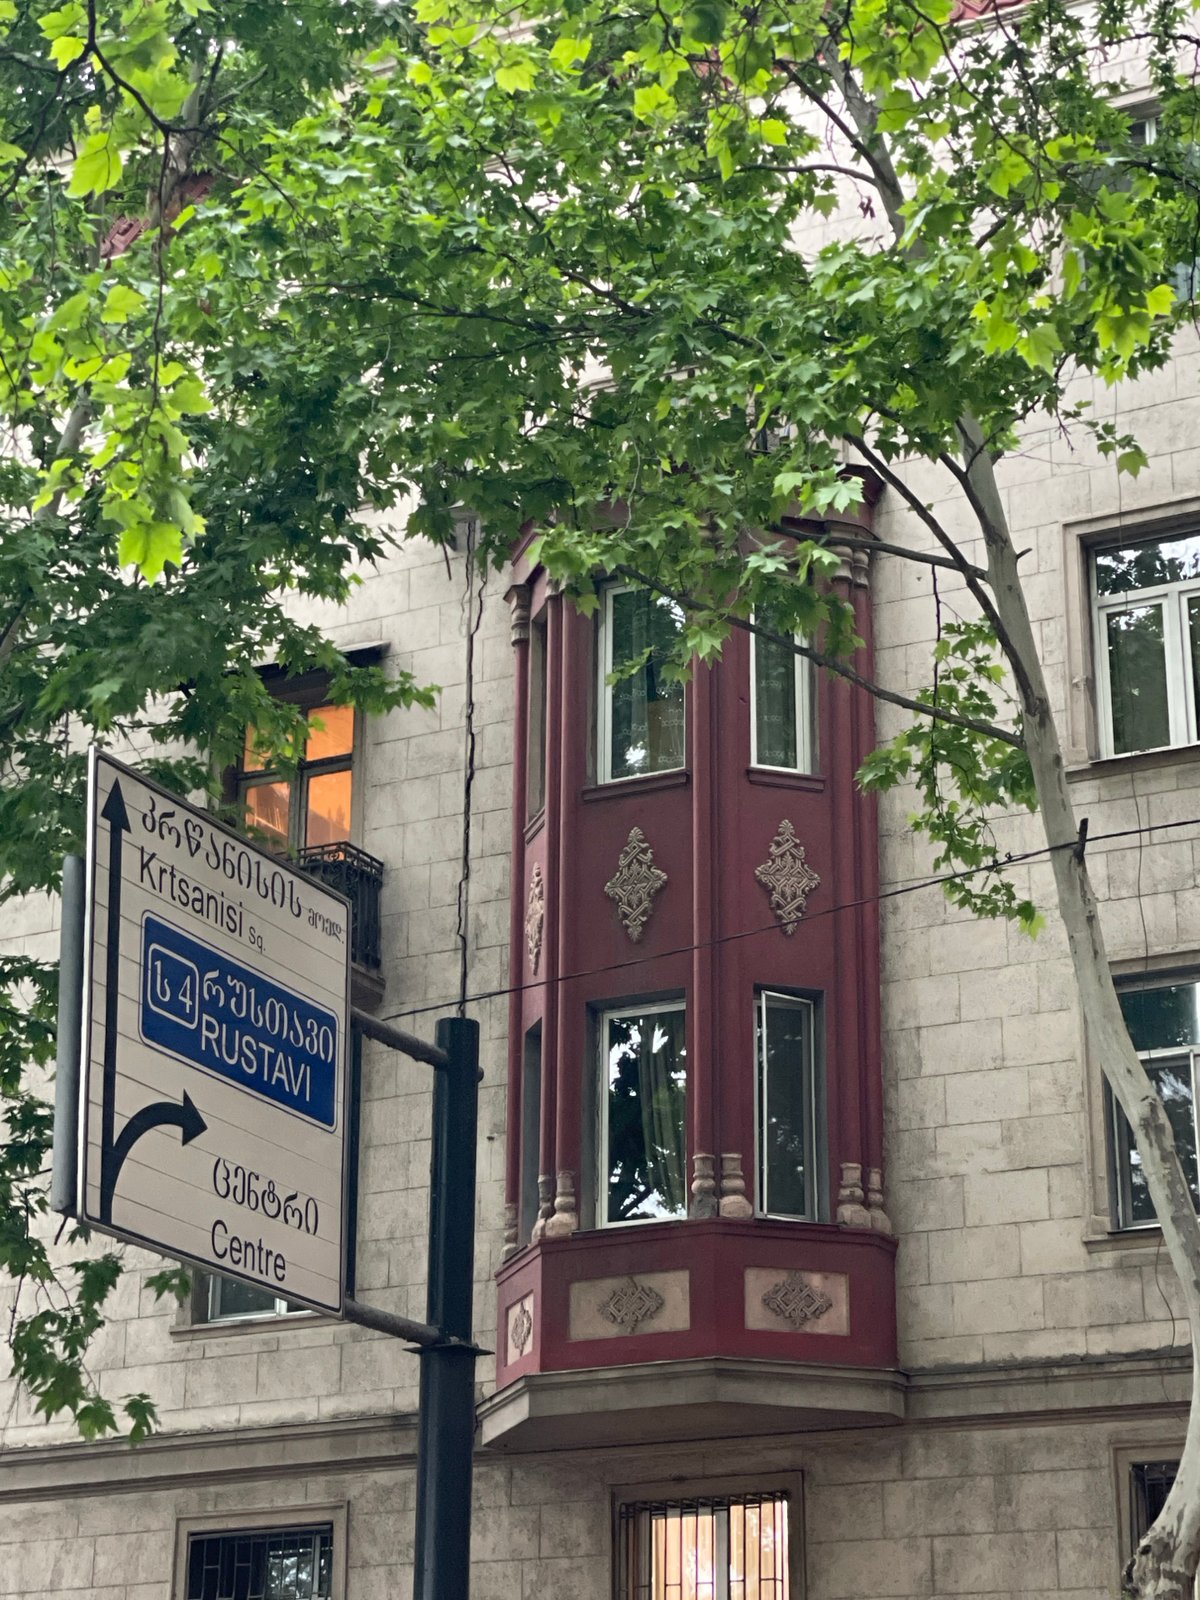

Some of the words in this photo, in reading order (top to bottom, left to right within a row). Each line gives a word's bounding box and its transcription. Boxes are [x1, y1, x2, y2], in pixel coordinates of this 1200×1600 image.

[139, 846, 243, 937] Krtsanisi
[248, 926, 266, 954] Sq.
[142, 796, 301, 917] კრწანისის
[308, 908, 345, 944] მოედ.
[201, 1013, 311, 1102] RUSTAVI
[203, 969, 333, 1063] რუსთავი
[213, 1157, 319, 1236] ცენტრი
[211, 1219, 286, 1282] Centre
